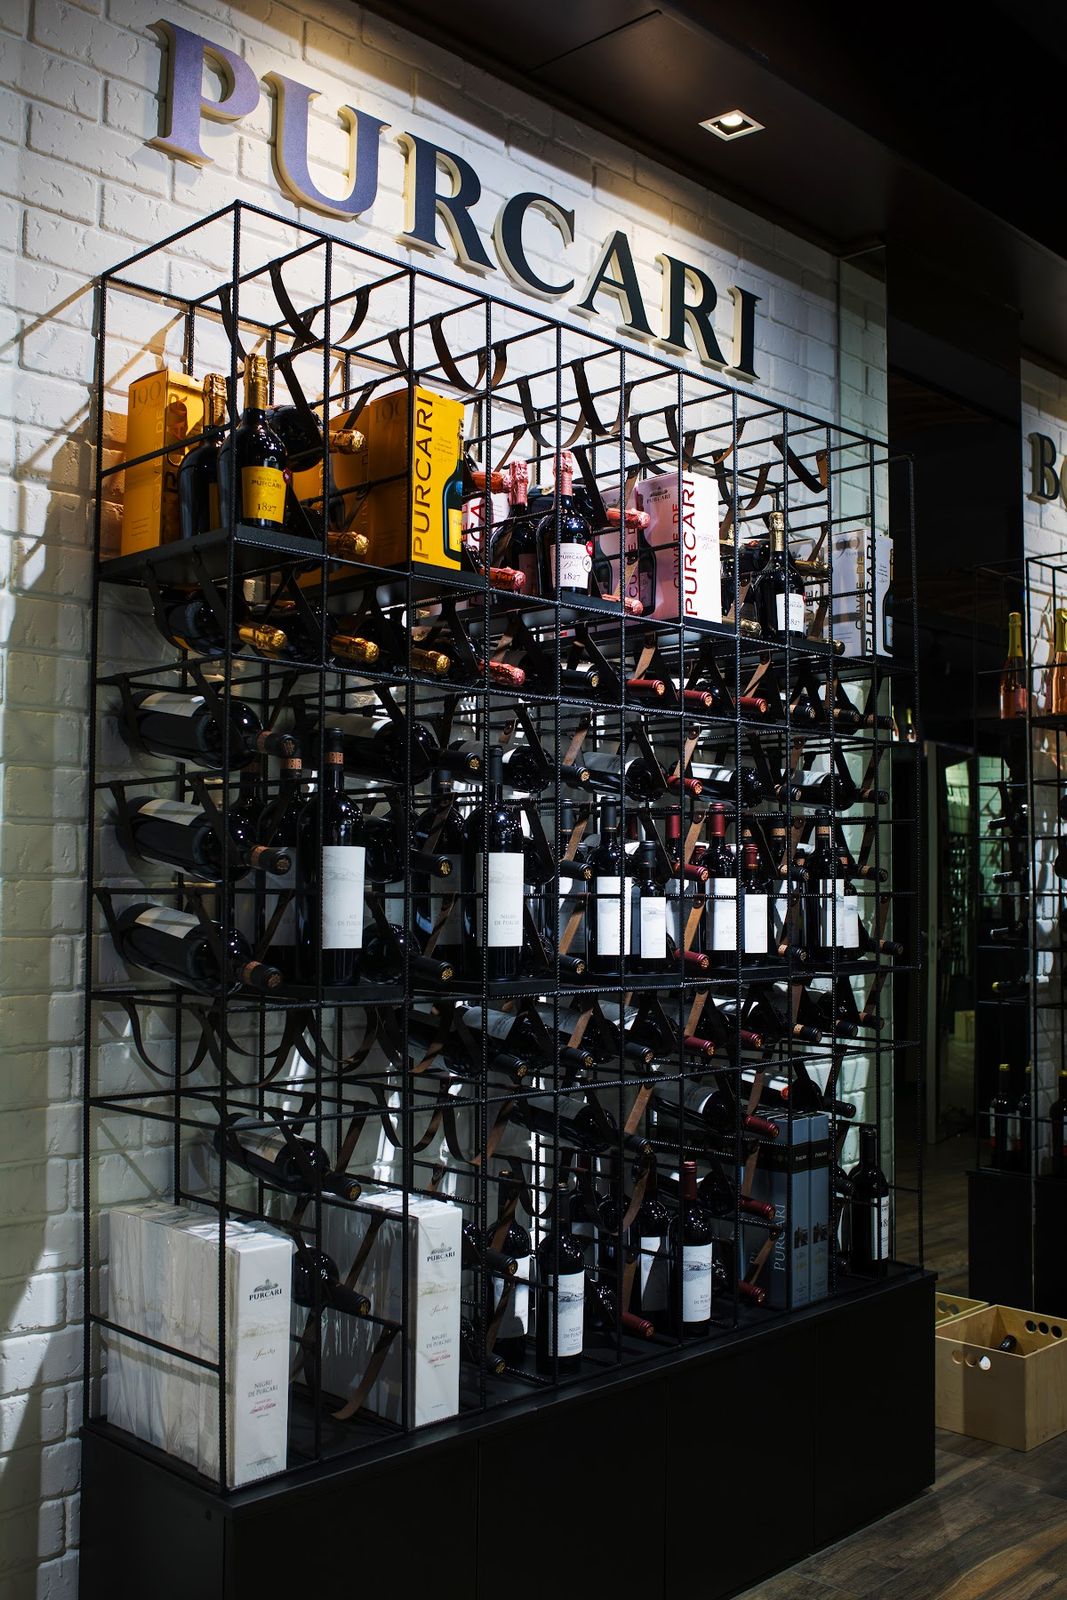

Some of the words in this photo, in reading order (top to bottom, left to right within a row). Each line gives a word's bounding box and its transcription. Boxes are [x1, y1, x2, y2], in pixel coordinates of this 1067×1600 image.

[146, 19, 762, 381] PURCARI
[413, 396, 433, 560] PURCARI
[257, 502, 277, 514] 1827
[682, 479, 698, 616] PURCARI
[563, 572, 581, 582] 1827
[427, 1250, 455, 1262] PURCARI
[249, 1288, 282, 1301] PURCARI
